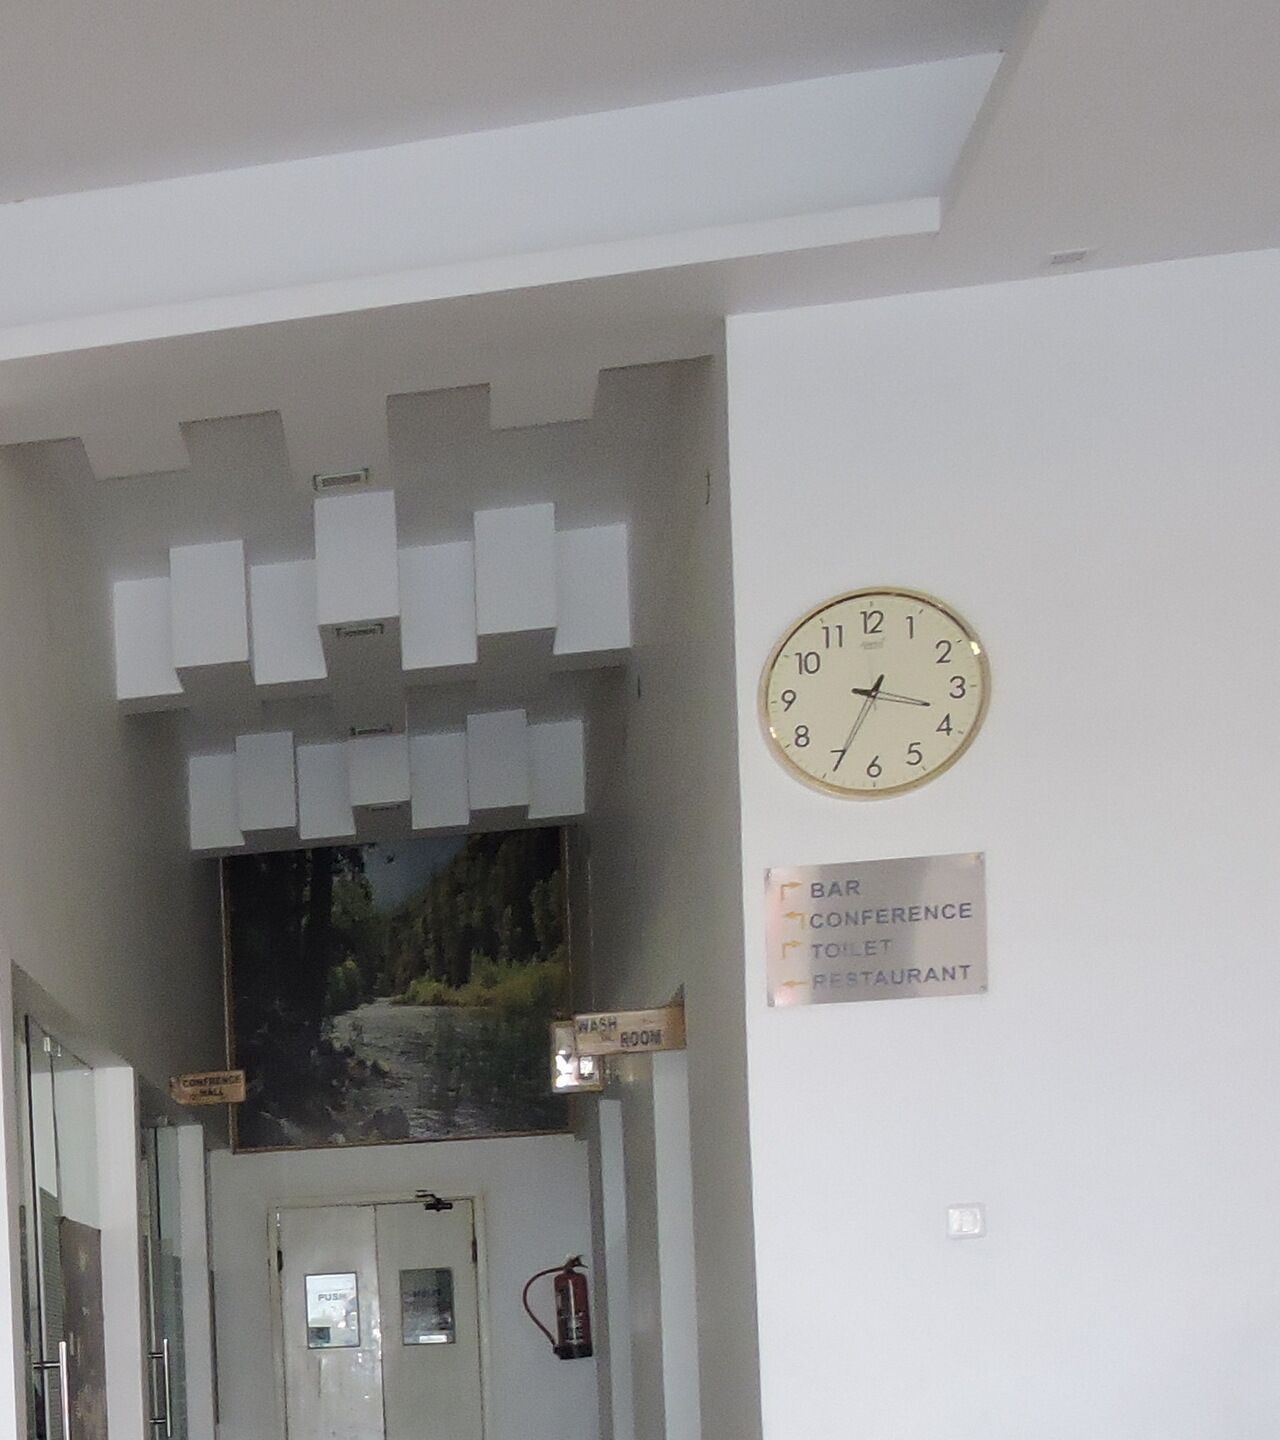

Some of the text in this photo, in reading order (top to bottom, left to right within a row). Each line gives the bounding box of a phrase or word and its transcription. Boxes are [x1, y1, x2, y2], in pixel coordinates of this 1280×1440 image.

[859, 610, 884, 634] 12
[905, 616, 914, 639] 1
[821, 625, 843, 648] 11
[794, 651, 820, 675] 10
[935, 640, 952, 664] 2
[949, 675, 966, 699] 3
[781, 689, 797, 712] 9
[794, 725, 810, 747] 8
[936, 713, 953, 736] 4
[830, 749, 847, 772] 7
[906, 742, 923, 765] 5
[866, 755, 882, 778] 6
[810, 880, 861, 898] BAR
[809, 903, 972, 929] CONFERENCE
[812, 965, 971, 990] RESTAURANT
[579, 1016, 617, 1032] WASH
[620, 1029, 662, 1047] ROOM
